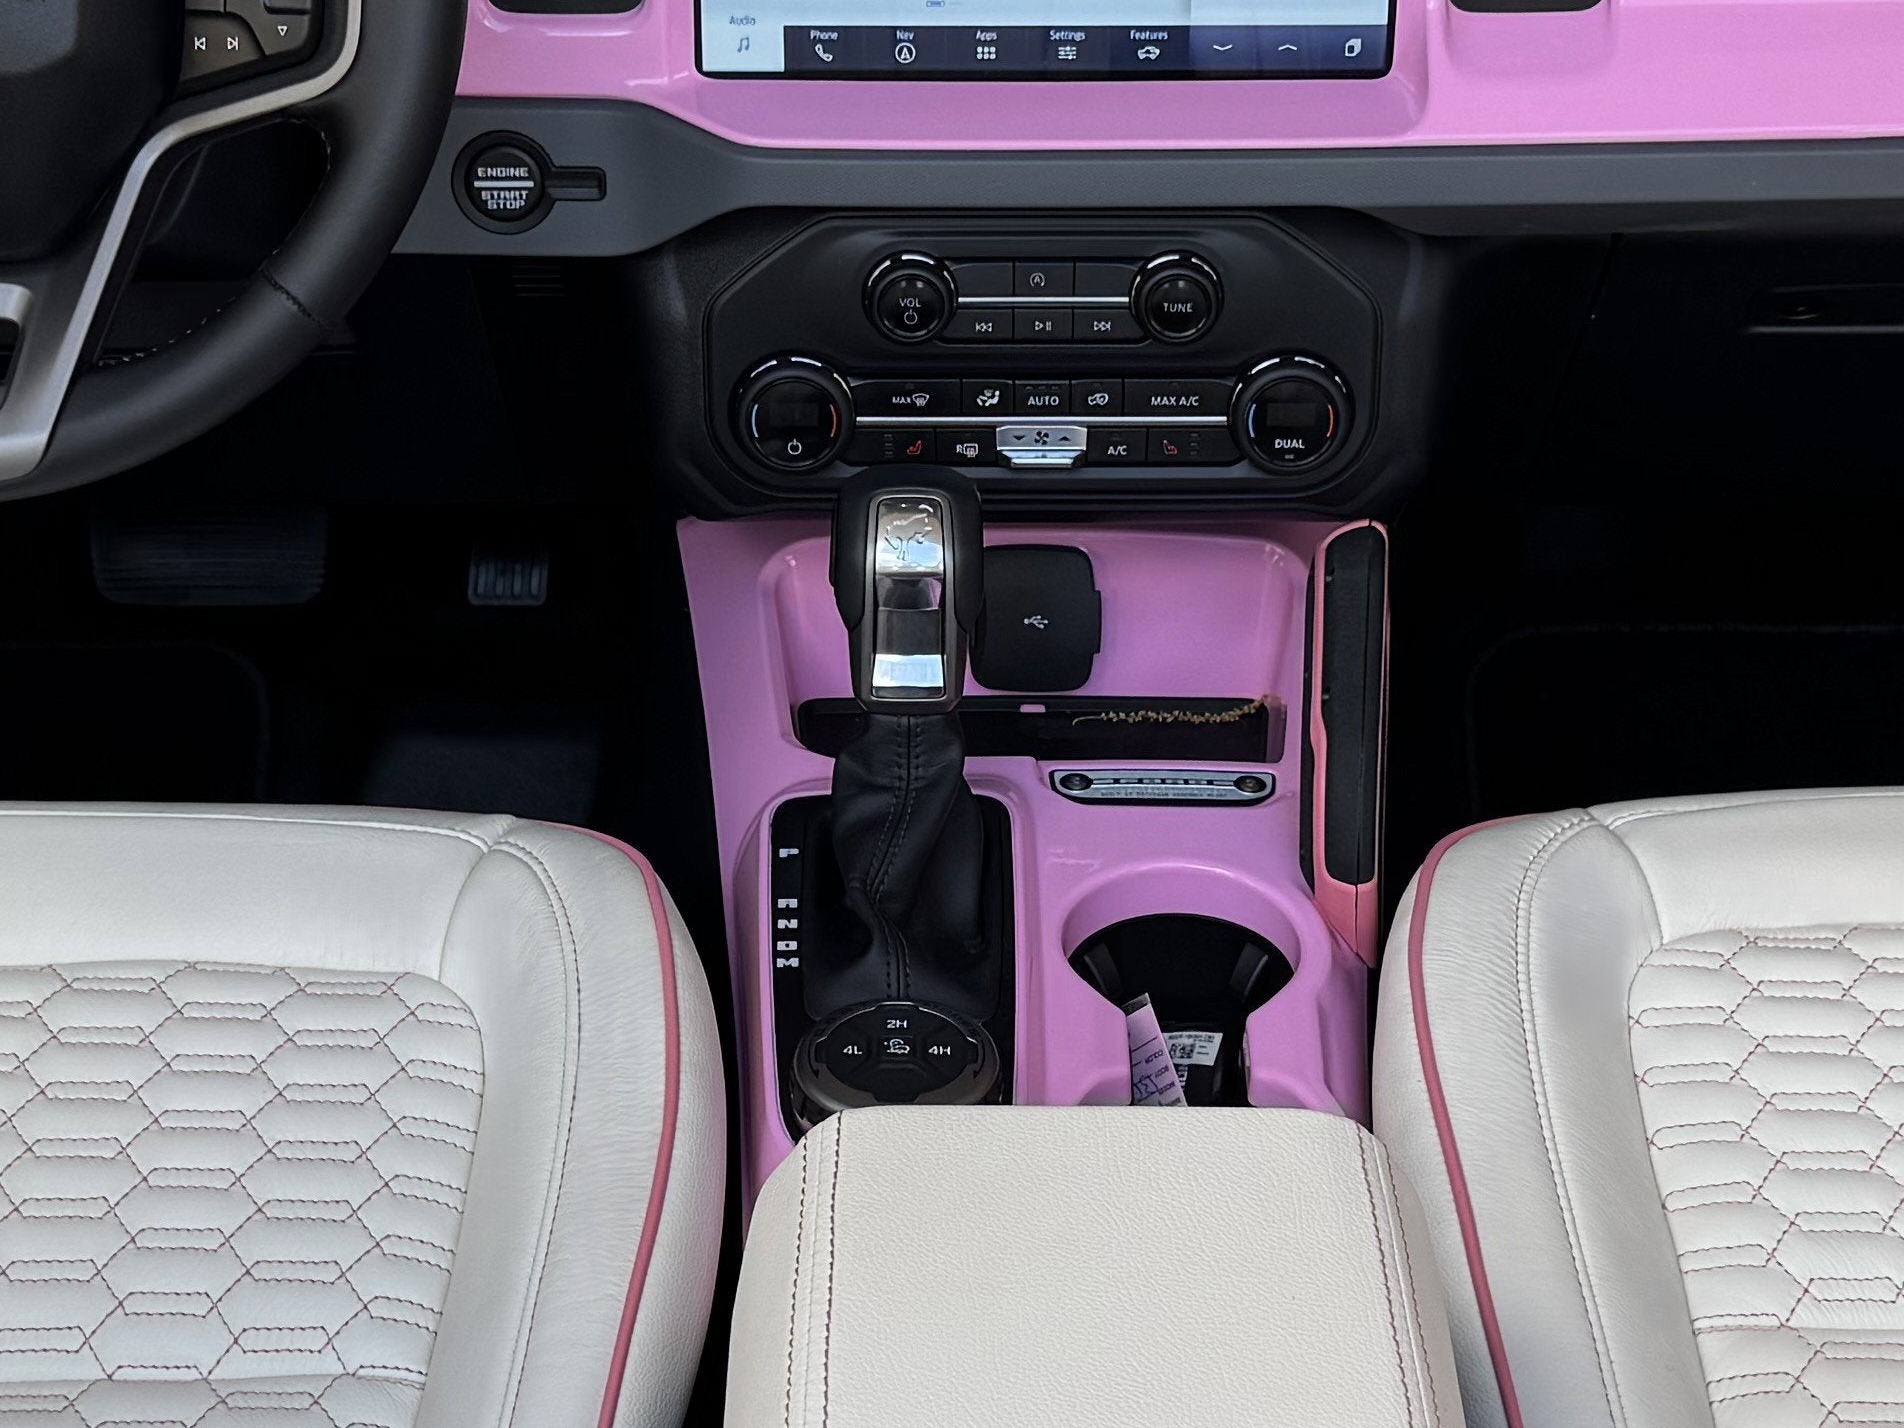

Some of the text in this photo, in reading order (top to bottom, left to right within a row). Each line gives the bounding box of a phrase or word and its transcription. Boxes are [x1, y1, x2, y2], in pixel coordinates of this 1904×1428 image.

[728, 14, 756, 26] Audio
[809, 29, 838, 41] Phone
[896, 30, 915, 41] Nav
[976, 30, 998, 42] Apps
[1049, 30, 1086, 42] Settings
[1129, 30, 1168, 41] Features
[477, 166, 529, 178] ENGINE
[481, 190, 529, 200] START
[487, 199, 526, 210] STOP
[899, 297, 922, 308] VOL
[1162, 302, 1194, 313] TUNE
[892, 395, 913, 405] MAX
[1027, 395, 1060, 406] AUTO
[1150, 395, 1199, 407] MAX A/C
[1274, 438, 1306, 449] DUAL
[1107, 444, 1128, 457] A/C
[777, 918, 798, 929] N
[776, 957, 800, 968] M
[886, 1019, 908, 1029] 2H
[842, 1045, 863, 1055] 4L
[927, 1045, 951, 1056] 4H
